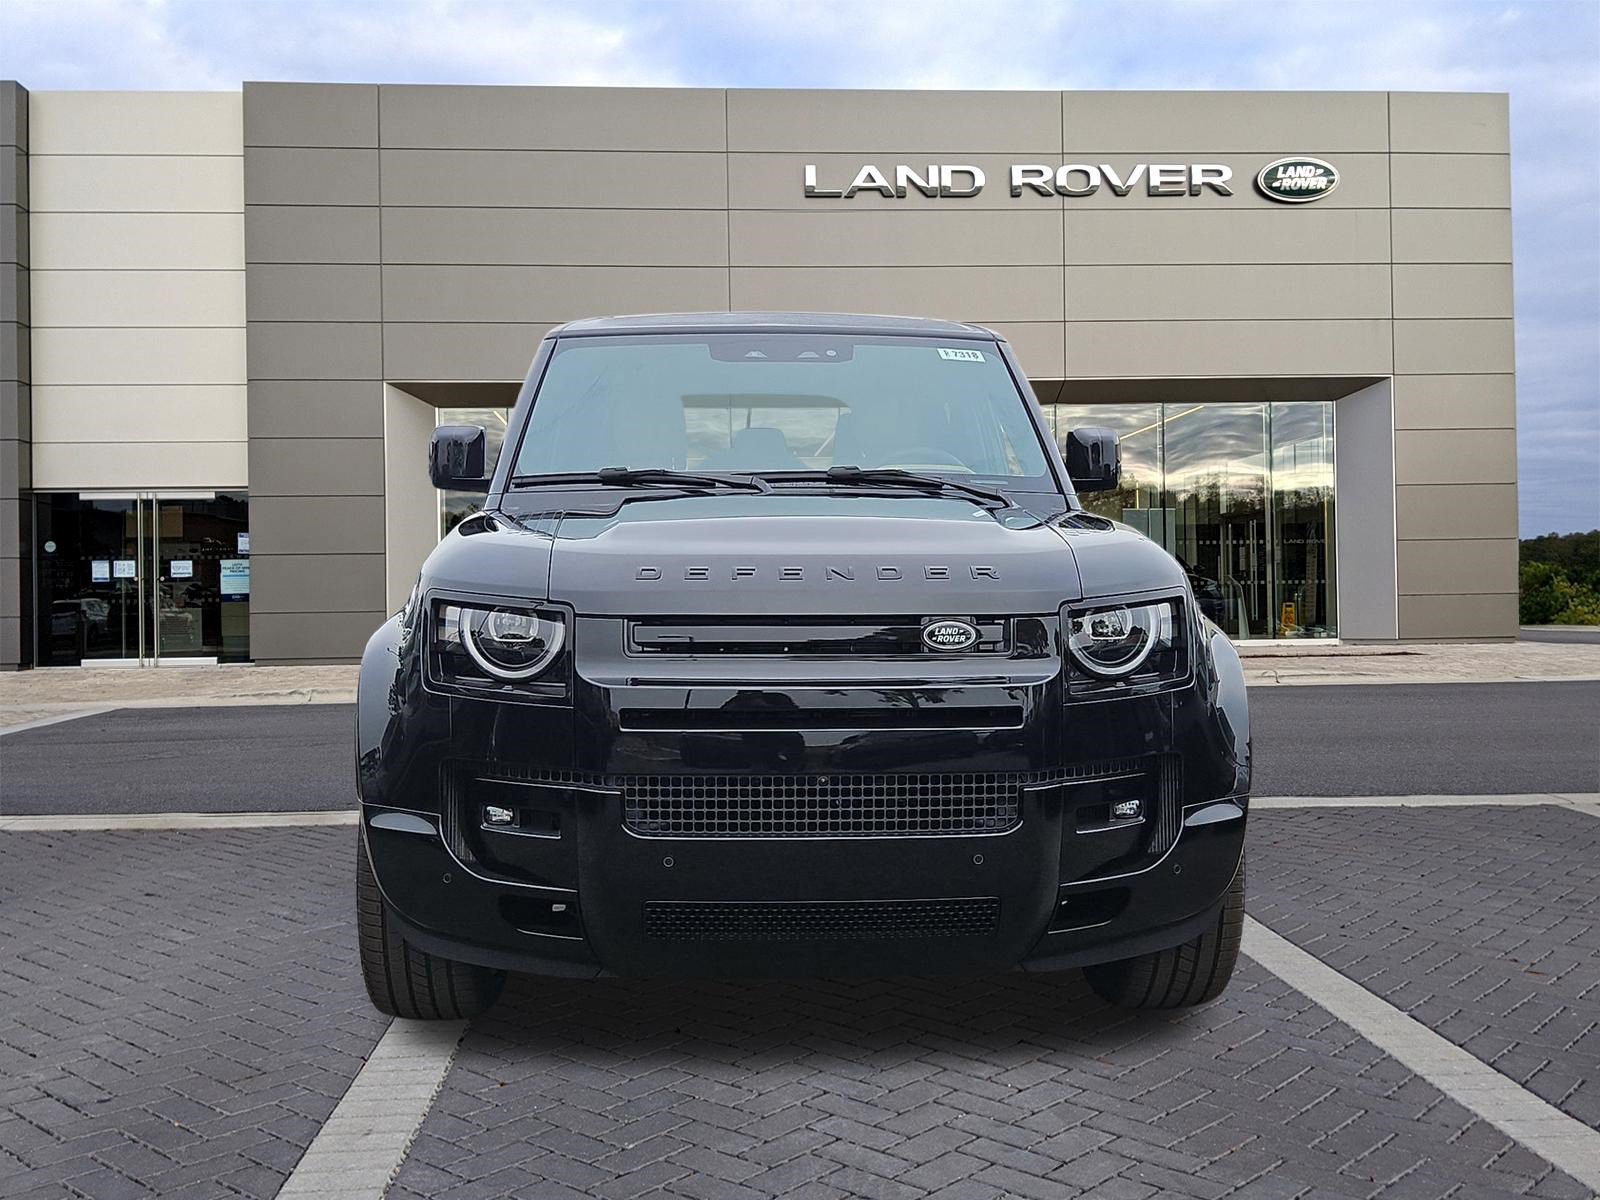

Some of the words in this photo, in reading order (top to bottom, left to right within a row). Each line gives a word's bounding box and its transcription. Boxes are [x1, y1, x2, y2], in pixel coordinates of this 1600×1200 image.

[1277, 165, 1316, 179] LAND
[804, 164, 986, 198] LAND
[1009, 163, 1235, 198] ROVER
[1280, 177, 1328, 190] ROVER
[635, 565, 1001, 581] DEFENDER
[935, 627, 959, 635] LAND
[936, 634, 966, 643] ROVER
